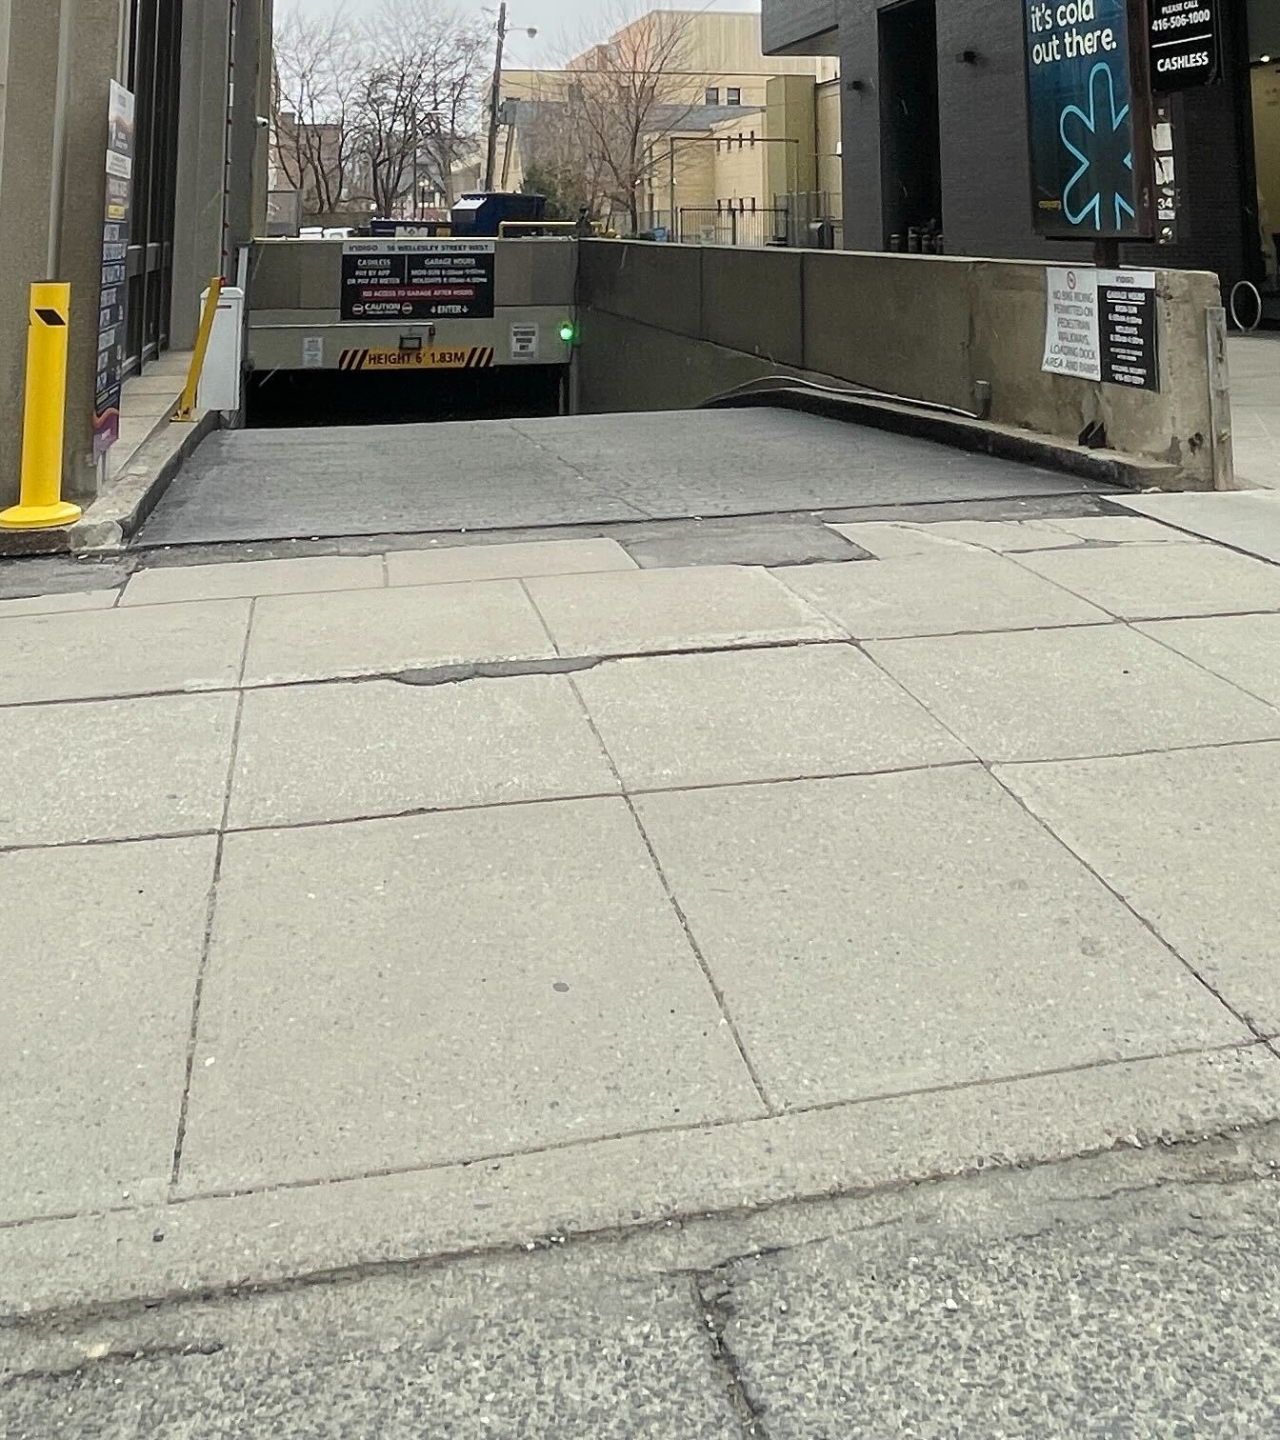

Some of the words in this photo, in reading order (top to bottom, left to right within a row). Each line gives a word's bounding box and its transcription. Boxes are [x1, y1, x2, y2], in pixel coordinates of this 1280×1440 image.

[1031, 2, 1052, 33] it's
[1161, 3, 1183, 14] PLEASE
[1183, 0, 1198, 9] CALL
[1152, 9, 1210, 31] 416-506-1000
[1032, 34, 1061, 65] out
[1064, 28, 1117, 58] there.
[1157, 52, 1209, 72] CASHLESS
[368, 351, 410, 364] HEIGHT
[431, 351, 465, 364] 1.83M
